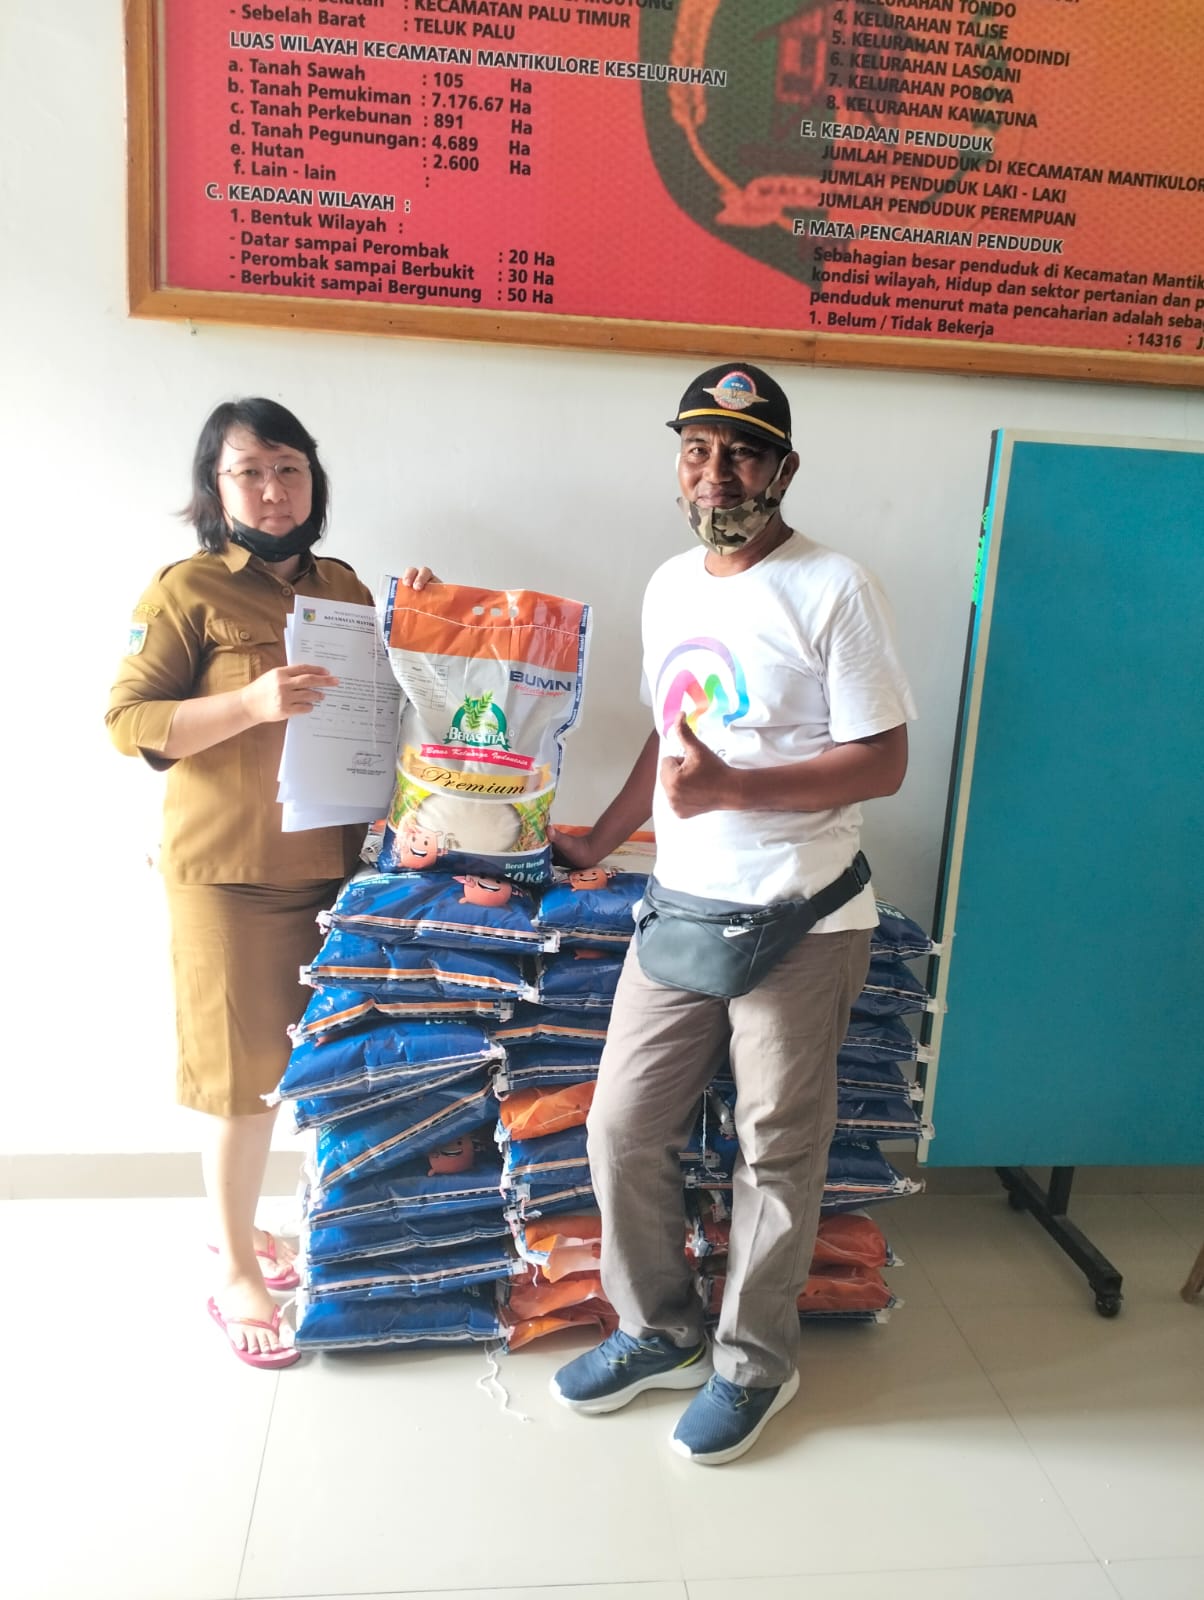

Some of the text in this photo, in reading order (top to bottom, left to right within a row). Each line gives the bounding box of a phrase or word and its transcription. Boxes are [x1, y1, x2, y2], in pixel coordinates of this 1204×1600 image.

[242, 5, 311, 24] Sebelah
[318, 10, 366, 28] Barat
[414, 17, 467, 36] TELUK
[472, 22, 515, 40] PALU
[414, 0, 522, 18] KECAMATAN
[528, 5, 571, 23] PALU
[576, 10, 631, 28] TIMUR
[833, 9, 1009, 40] 4. KELURAHAN TALISE
[853, 0, 1017, 18] RAHAN TONDO
[231, 32, 727, 87] LUAS WILAYAH KECAMATAN MANTIKULORE KESELURUHAN
[832, 30, 1070, 67] 5. KELURAHAN TANAMODINDI
[229, 60, 243, 73] a.
[250, 58, 301, 77] Tanah
[307, 62, 365, 81] Sawah
[434, 72, 464, 88] 105
[510, 79, 532, 94] Ha
[830, 52, 1021, 83] 6. KELURAHAN LASOANI
[228, 78, 244, 94] b.
[250, 80, 302, 97] Tanah
[308, 83, 411, 106] Pemukiman
[431, 92, 504, 112] 7.176.67
[510, 99, 532, 114] Ha
[828, 73, 1014, 104] 7. KELURAHAN POBOYA
[230, 104, 244, 115] c.
[250, 101, 302, 118] Tanah
[308, 104, 412, 126] Perkebunan
[434, 113, 464, 129] 891
[511, 120, 533, 135] Ha
[826, 95, 1038, 128] 8. KELURAHAN KAWATUNA
[229, 120, 245, 136] d.
[251, 121, 303, 139] Tanah
[308, 125, 419, 150] Pegunungan
[432, 134, 479, 151] 4.689
[509, 140, 531, 156] Ha
[801, 121, 993, 152] E. KEADAAN PENDUDUK
[230, 143, 245, 155] e.
[252, 142, 304, 159] Hutan
[433, 155, 479, 172] 2.600
[510, 160, 531, 175] Ha
[233, 159, 245, 174] f.
[252, 161, 287, 177] Lain
[304, 164, 336, 181] lain
[822, 146, 887, 165] JUMLAH
[892, 152, 980, 173] PENDUDUK
[985, 158, 1001, 174] DI
[1007, 161, 1103, 183] KECAMATAN
[205, 184, 222, 200] C.
[229, 185, 313, 205] KEADAAN
[318, 190, 395, 211] WILAYAH
[820, 169, 885, 188] JUMLAH
[891, 175, 977, 197] PENDUDUK
[983, 182, 1018, 200] LAKI
[1032, 186, 1066, 204] LAKI
[230, 209, 245, 224] 1.
[251, 210, 313, 228] Bentuk
[318, 214, 387, 234] Wilayah
[818, 192, 1076, 227] JUMLAH PENDUDUK PEREMPUAN
[241, 230, 289, 249] Datar
[295, 235, 357, 254] sampai
[363, 239, 449, 260] Perombak
[509, 250, 529, 265] 20
[534, 252, 555, 266] Ha
[793, 219, 1063, 254] F. MATA PENCAHARIAN PENDUDUK
[241, 251, 328, 271] Perombak
[335, 256, 396, 276] sampai
[402, 261, 474, 281] Berbukit
[508, 269, 528, 285] 30
[533, 271, 554, 286] Ha
[814, 246, 907, 270] Sebahagian
[912, 253, 955, 271] besar
[960, 256, 1039, 280] penduduk
[1044, 262, 1058, 277] di
[1064, 265, 1148, 286] Kecamatan
[241, 270, 314, 289] Berbukit
[321, 274, 383, 294] sampai
[388, 279, 482, 302] Bergunung
[507, 288, 527, 303] 50
[532, 289, 553, 305] Ha
[812, 267, 870, 286] kondisi
[875, 270, 940, 291] wilayah,
[946, 276, 992, 296] Hidup
[997, 279, 1026, 296] dan
[1031, 281, 1079, 299] sektor
[1084, 287, 1158, 308] pertanian
[1163, 292, 1190, 308] dan
[810, 290, 1204, 333] penduduk menurut mata pencaharian adalah seba
[809, 311, 822, 326] 1.
[827, 311, 875, 329] Belum
[891, 315, 932, 334] Tidak
[937, 319, 994, 338] Bekerja
[1138, 332, 1182, 349] 14316
[510, 670, 571, 691] BUMN
[420, 767, 526, 794] Premium
